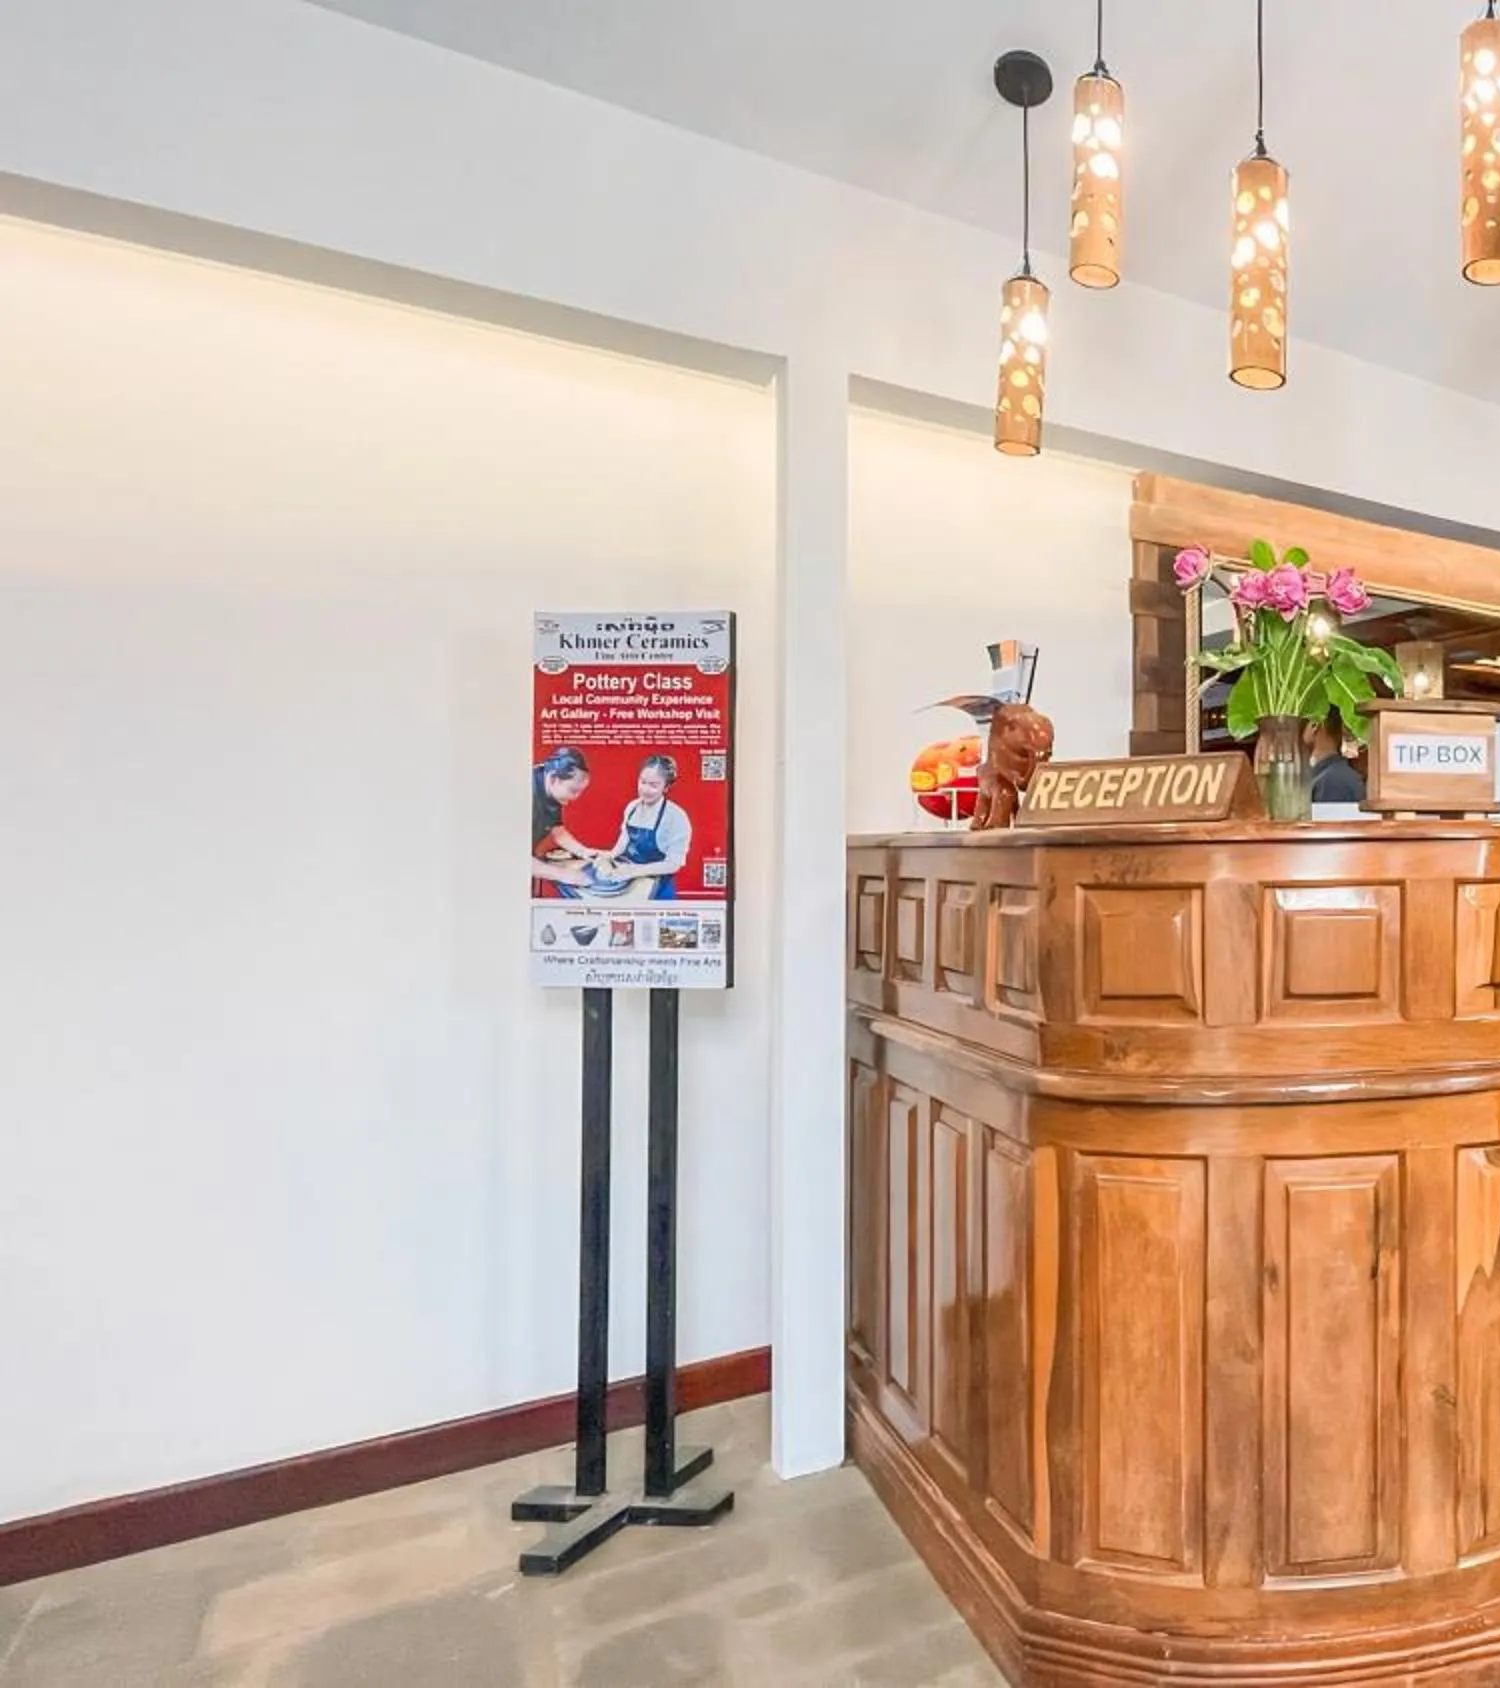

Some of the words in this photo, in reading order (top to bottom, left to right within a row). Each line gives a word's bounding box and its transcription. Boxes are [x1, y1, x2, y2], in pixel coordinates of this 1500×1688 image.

[559, 633, 621, 650] Khmer
[626, 633, 709, 650] Ceramics
[573, 673, 637, 693] Pottery
[643, 673, 693, 690] Class
[552, 694, 583, 705] Local
[585, 694, 649, 707] Community
[651, 694, 713, 707] Experience
[541, 709, 557, 719] Art
[560, 709, 600, 721] Gallery
[609, 709, 635, 719] Free
[637, 709, 693, 721] Workshop
[695, 709, 721, 719] Visit
[1394, 744, 1429, 764] TIP
[1437, 744, 1482, 764] BOX
[1028, 762, 1228, 811] RECEPTION
[543, 955, 575, 966] Where
